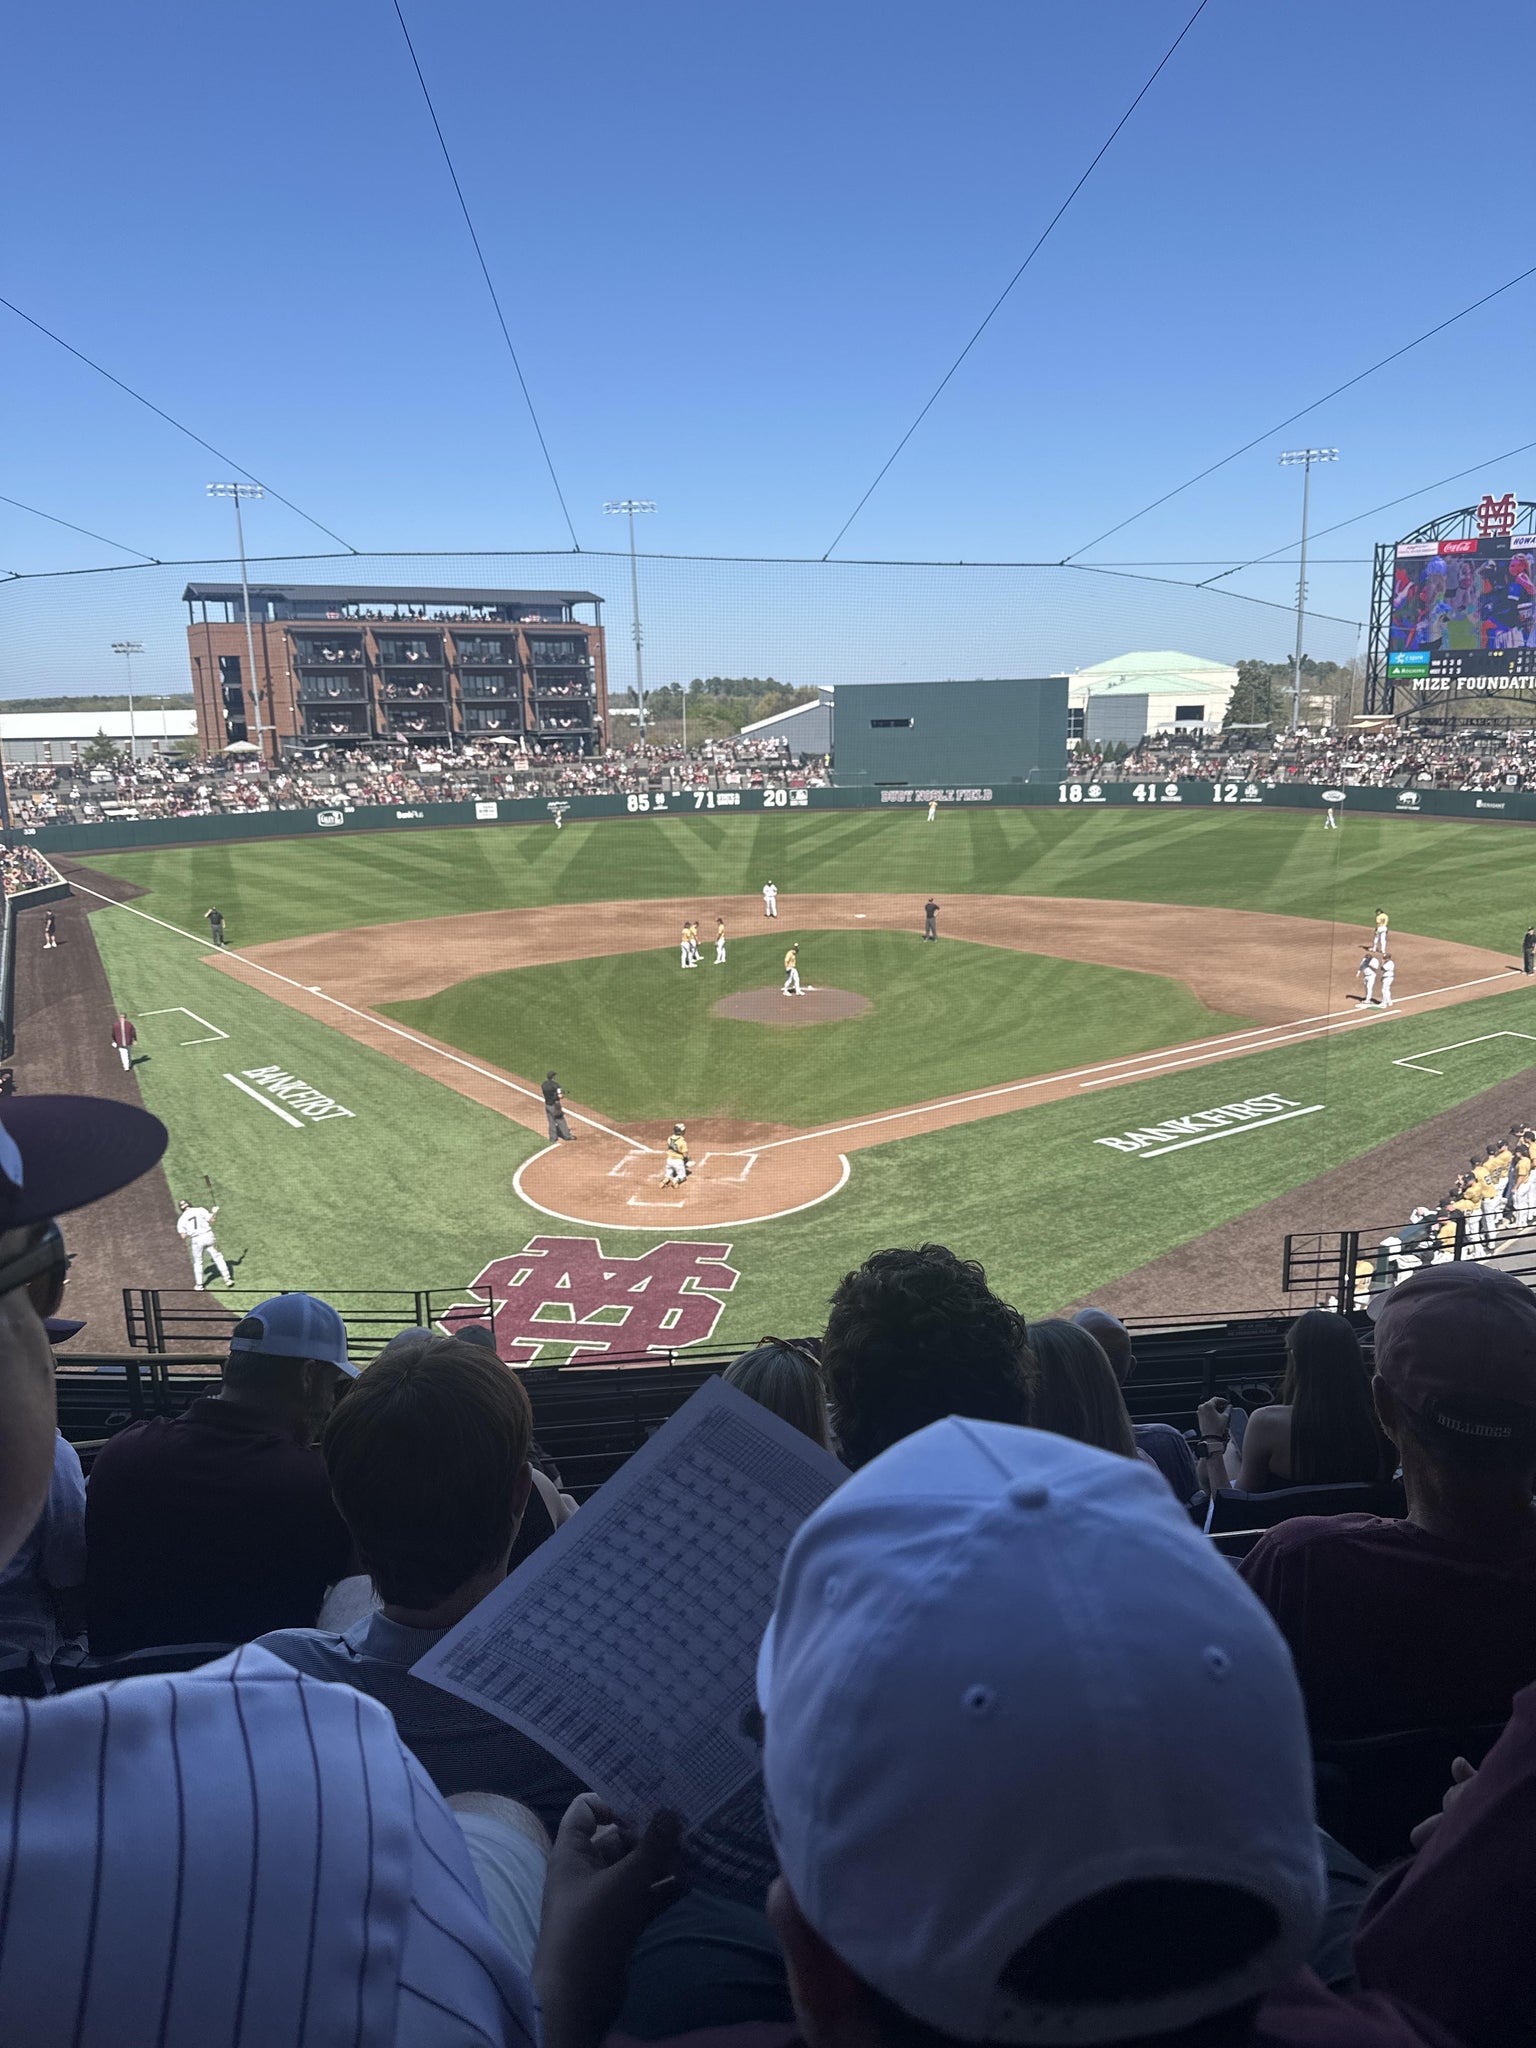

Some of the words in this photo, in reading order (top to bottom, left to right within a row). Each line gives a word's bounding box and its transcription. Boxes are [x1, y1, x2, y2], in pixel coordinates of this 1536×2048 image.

[1413, 678, 1450, 691] MIZE
[1457, 676, 1536, 690] FOUNDATI
[693, 791, 715, 808] 71
[763, 789, 787, 806] 20
[1059, 784, 1082, 802] 18
[1132, 784, 1156, 802] 41
[1213, 784, 1238, 802] 12
[627, 794, 650, 812] 85
[239, 1065, 356, 1122] BANKFIRST
[1093, 1092, 1301, 1152] BANKFIRST
[188, 1216, 197, 1230] 7
[1437, 1413, 1512, 1438] BULLDOGS
